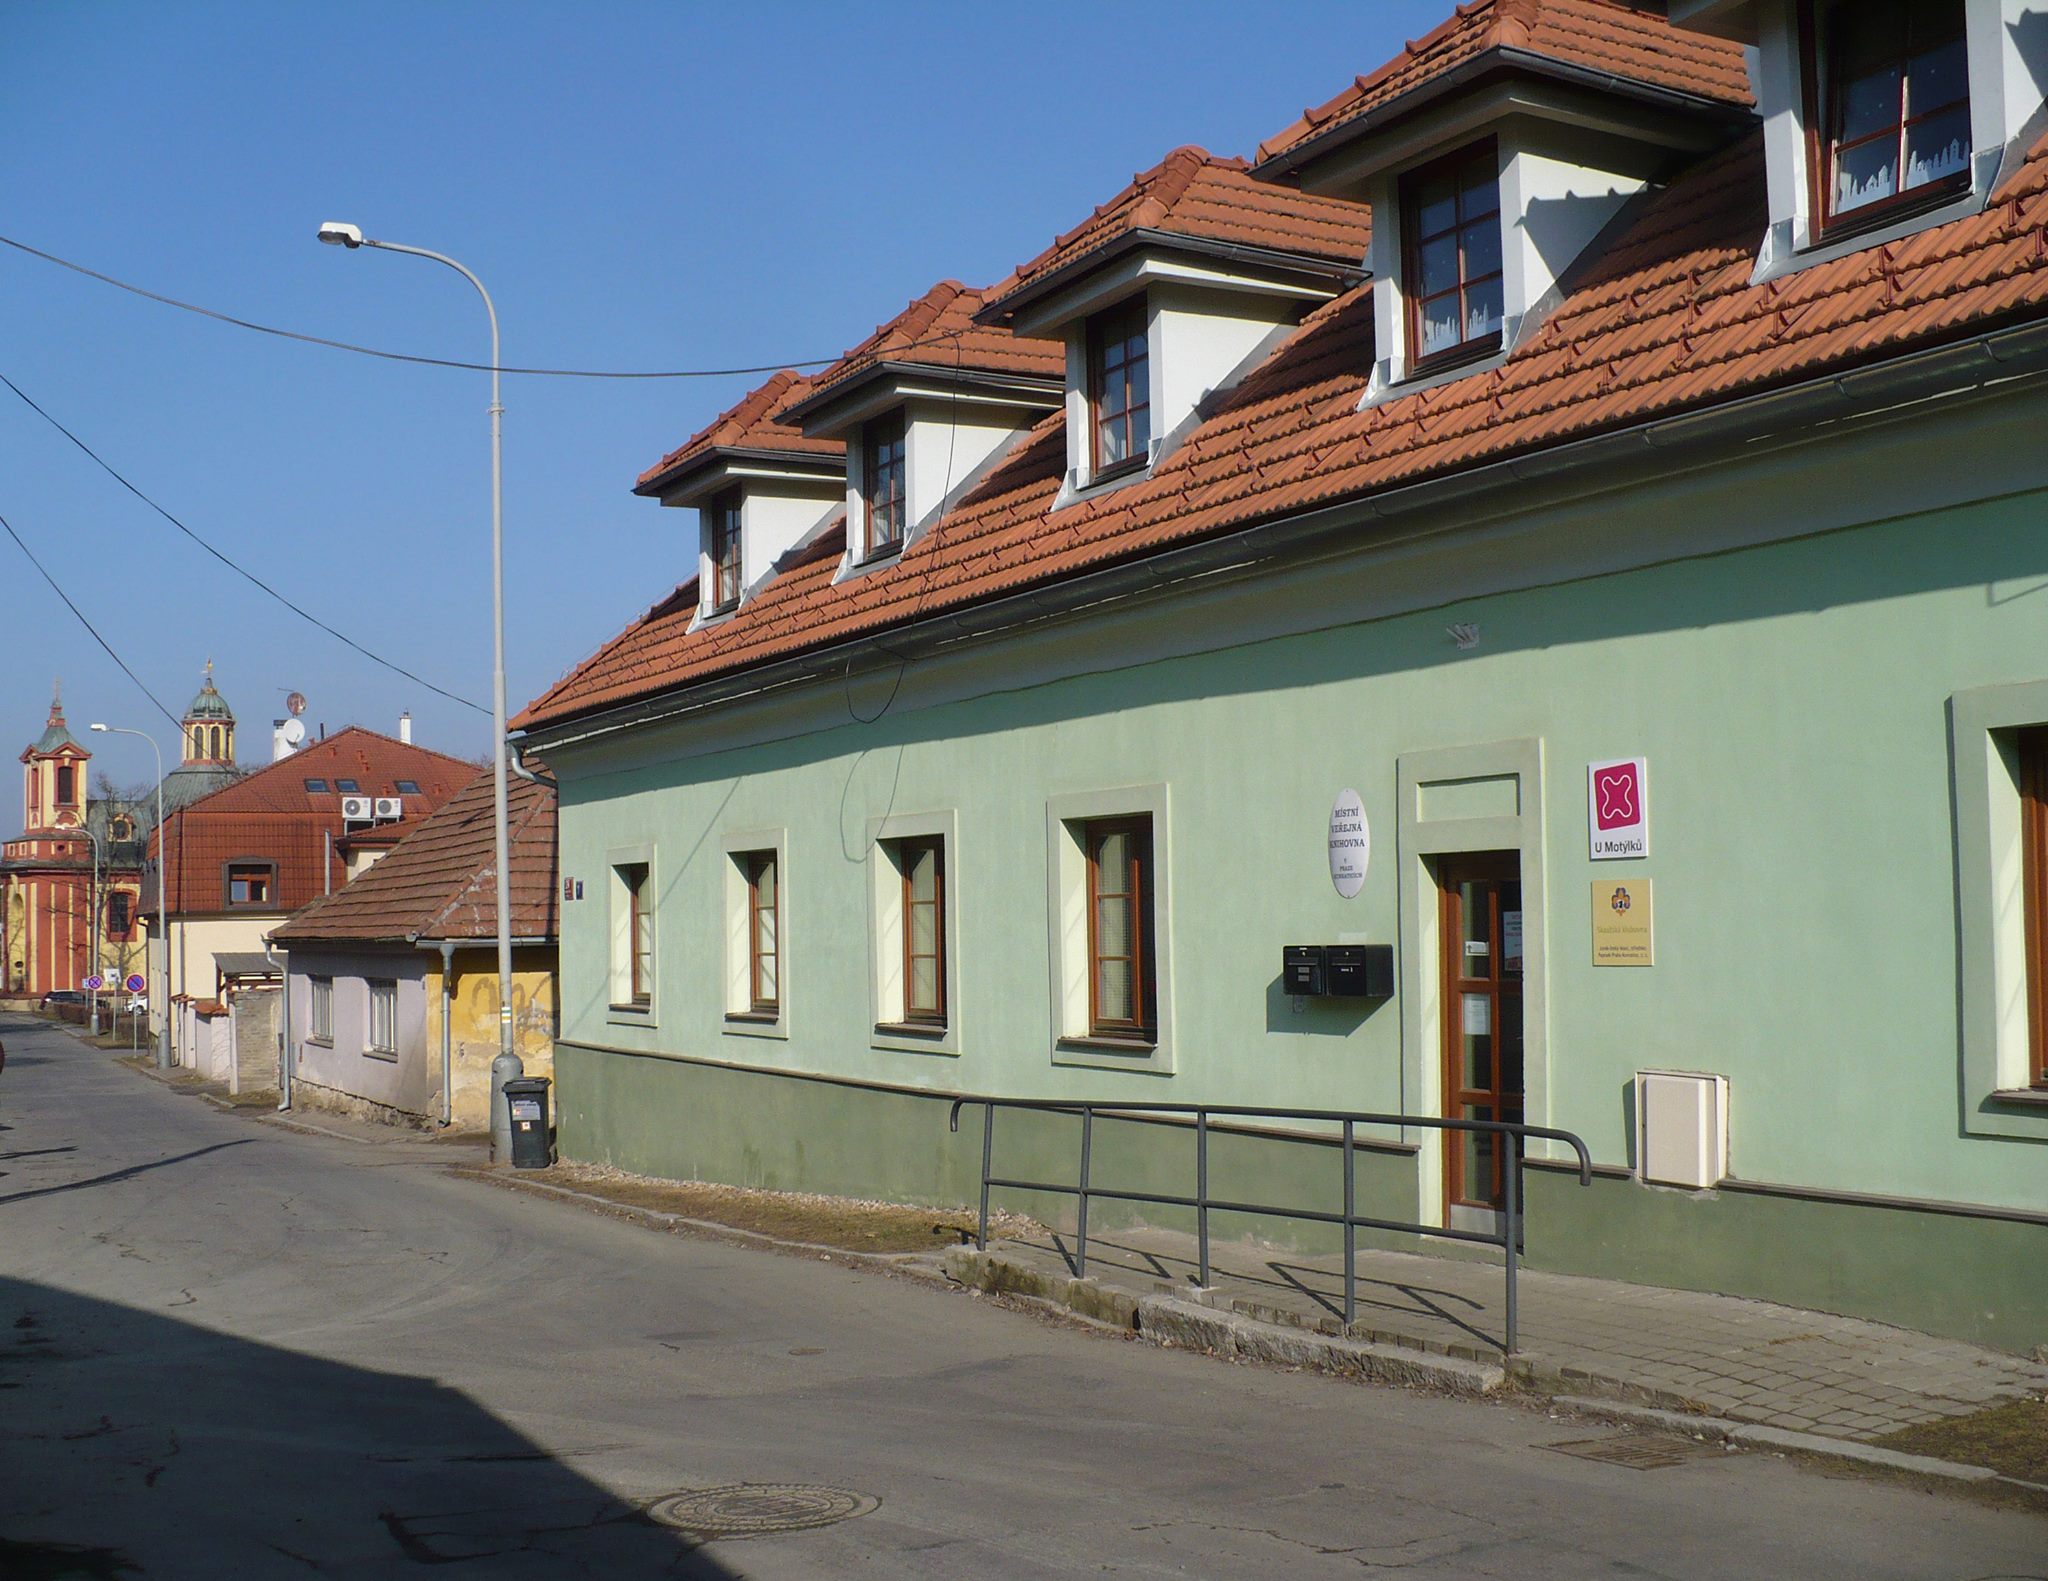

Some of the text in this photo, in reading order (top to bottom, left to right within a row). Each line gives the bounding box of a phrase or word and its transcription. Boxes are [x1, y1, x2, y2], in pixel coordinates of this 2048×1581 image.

[1335, 806, 1358, 817] MÍSTNÍ
[1331, 822, 1362, 833] VEŘEJNÁ
[1330, 839, 1365, 848] KNIHOVNA
[1595, 839, 1642, 855] U Motýlků
